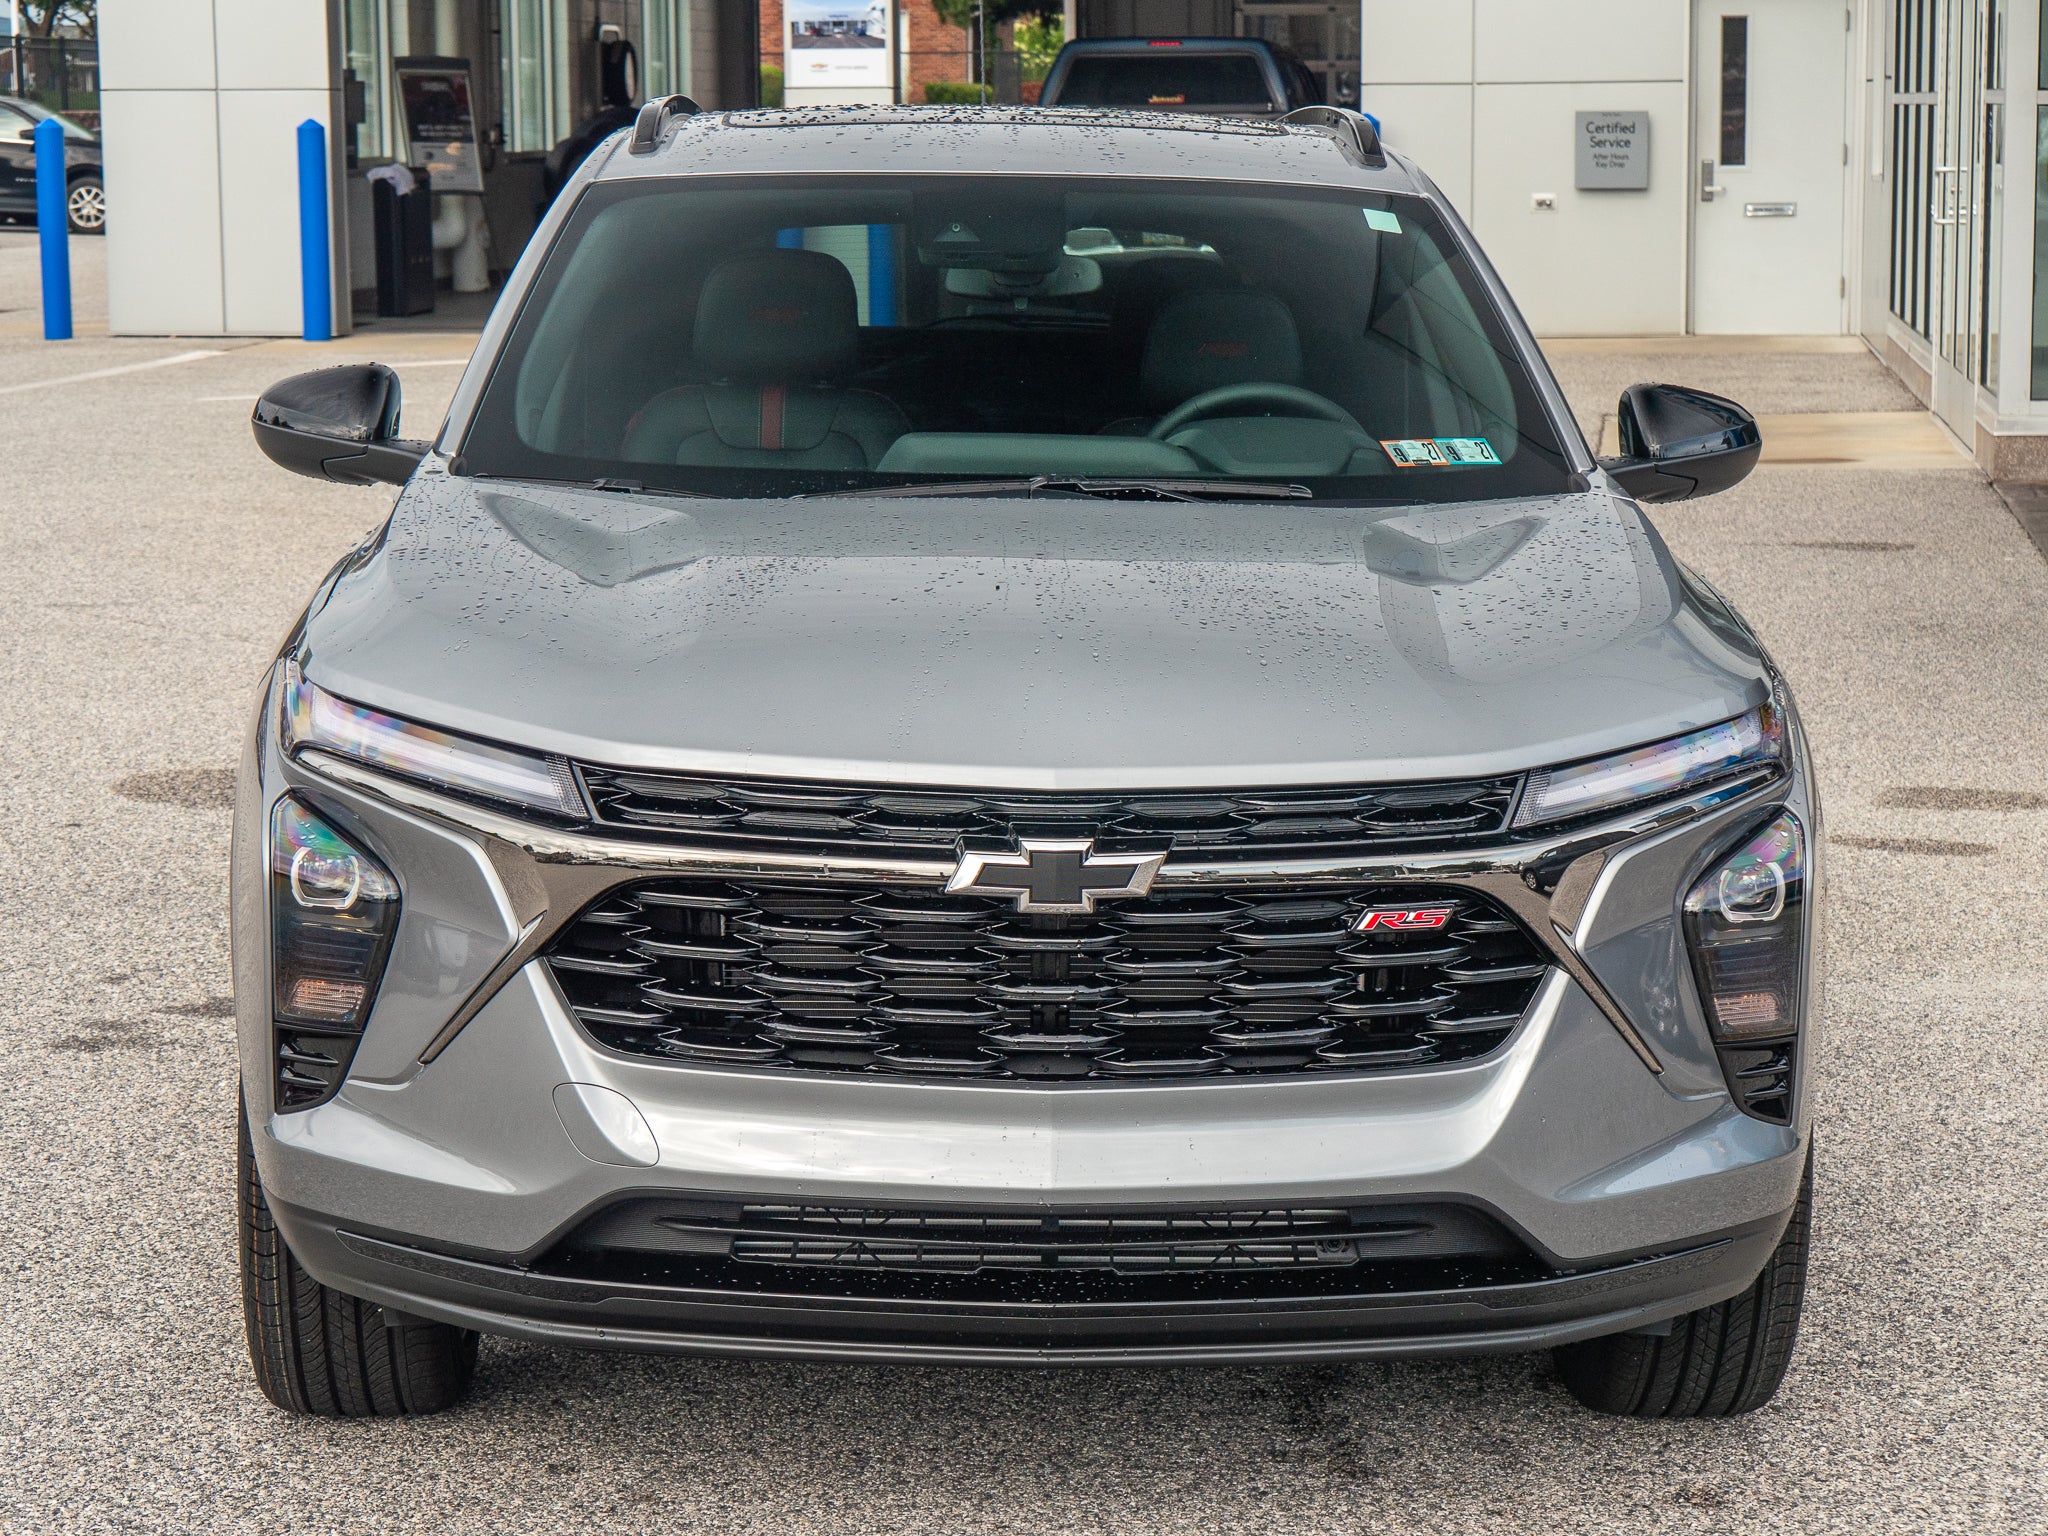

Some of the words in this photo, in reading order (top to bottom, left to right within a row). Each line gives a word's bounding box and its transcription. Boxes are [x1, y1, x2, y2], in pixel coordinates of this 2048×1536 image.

[1586, 122, 1635, 134] Certified
[1590, 136, 1631, 148] Service
[1393, 447, 1409, 463] 9
[1421, 442, 1442, 462] 27
[1445, 445, 1462, 461] 9
[1473, 441, 1495, 461] 27
[1356, 908, 1451, 931] RS
